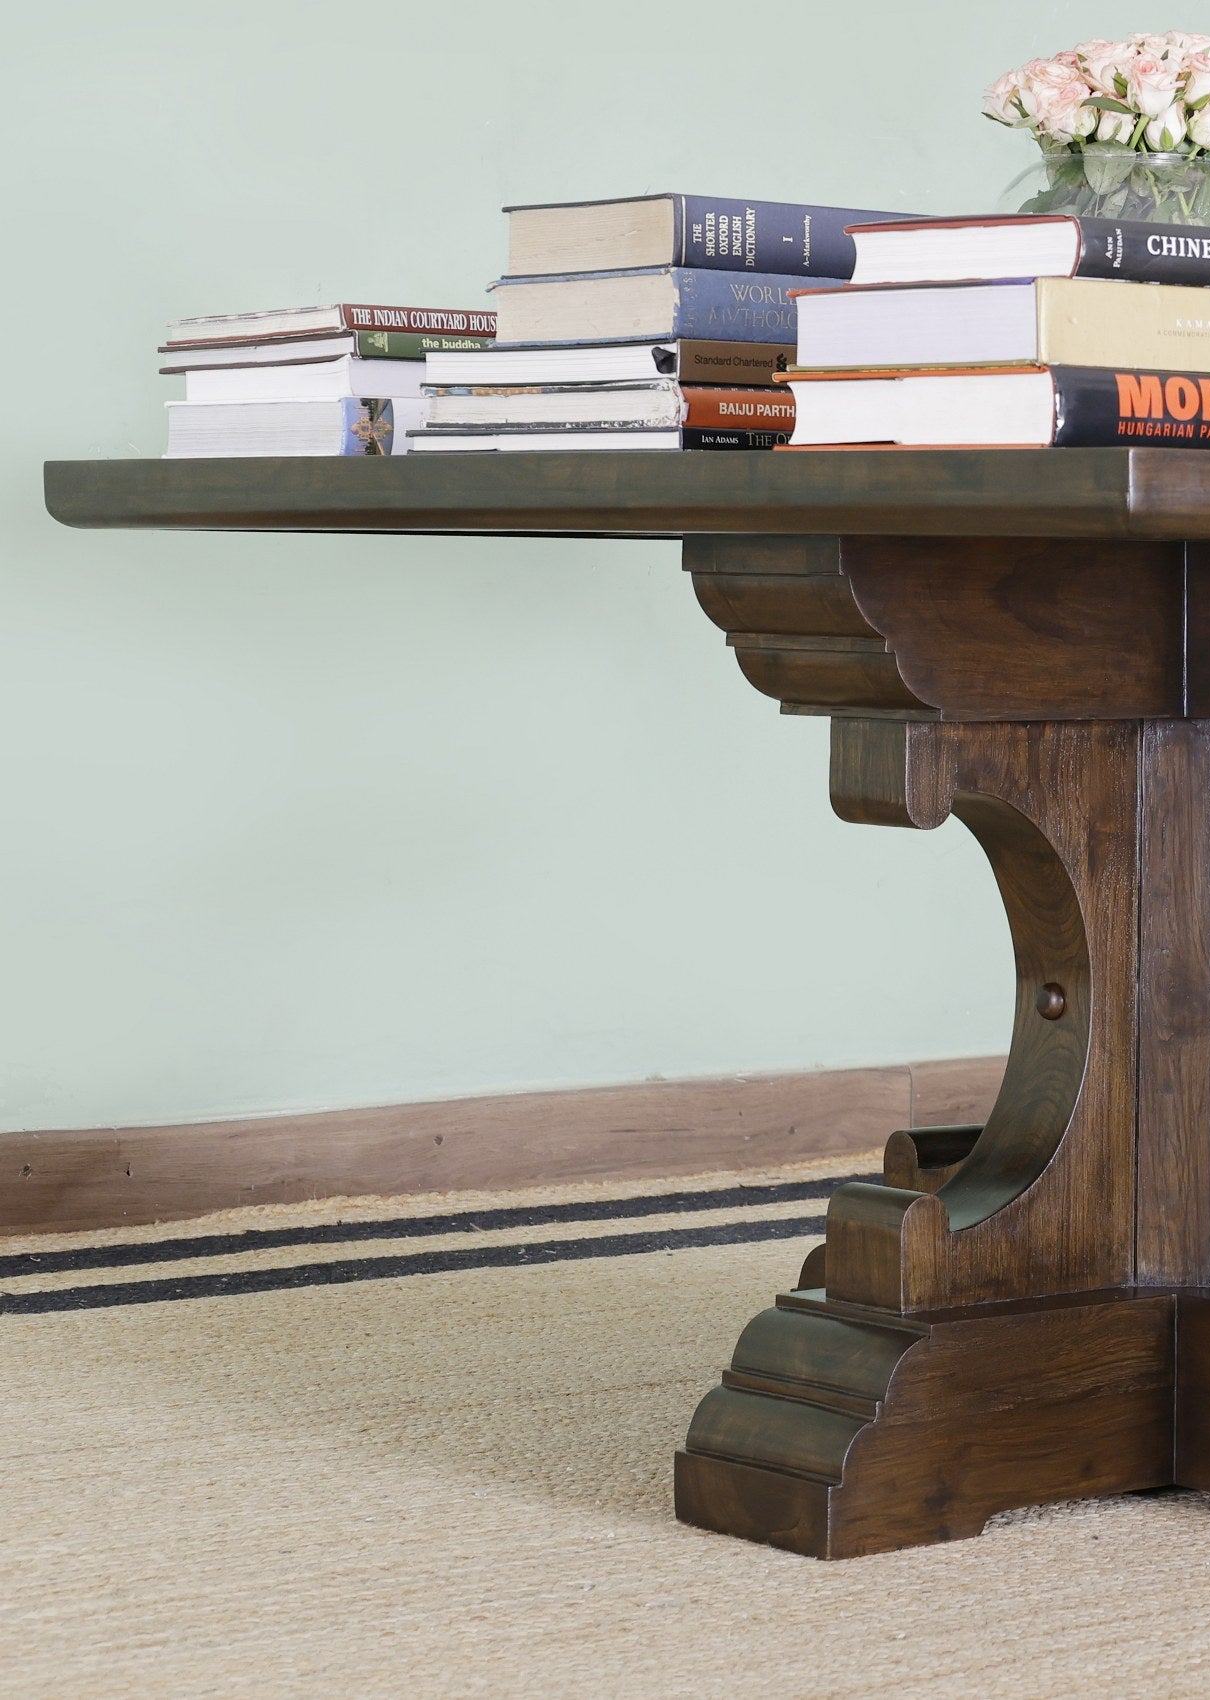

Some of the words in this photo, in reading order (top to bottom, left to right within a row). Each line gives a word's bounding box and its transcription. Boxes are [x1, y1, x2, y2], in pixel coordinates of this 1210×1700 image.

[692, 223, 702, 244] THE
[705, 212, 716, 257] SHORTER
[719, 215, 729, 255] OXFORD
[732, 216, 742, 257] ENGLISH
[745, 207, 756, 266] DICTIONARY
[351, 308, 371, 325] THE
[374, 309, 408, 328] INDIAN
[410, 311, 467, 330] COURTYARD
[421, 338, 440, 348] the
[441, 339, 481, 349] buddha
[694, 354, 732, 366] Standard
[732, 356, 773, 368] Chartered
[719, 402, 754, 416] BAIJU
[756, 404, 796, 418] PARTH
[745, 432, 772, 447] THE
[1117, 421, 1194, 438] HUNGARIAN
